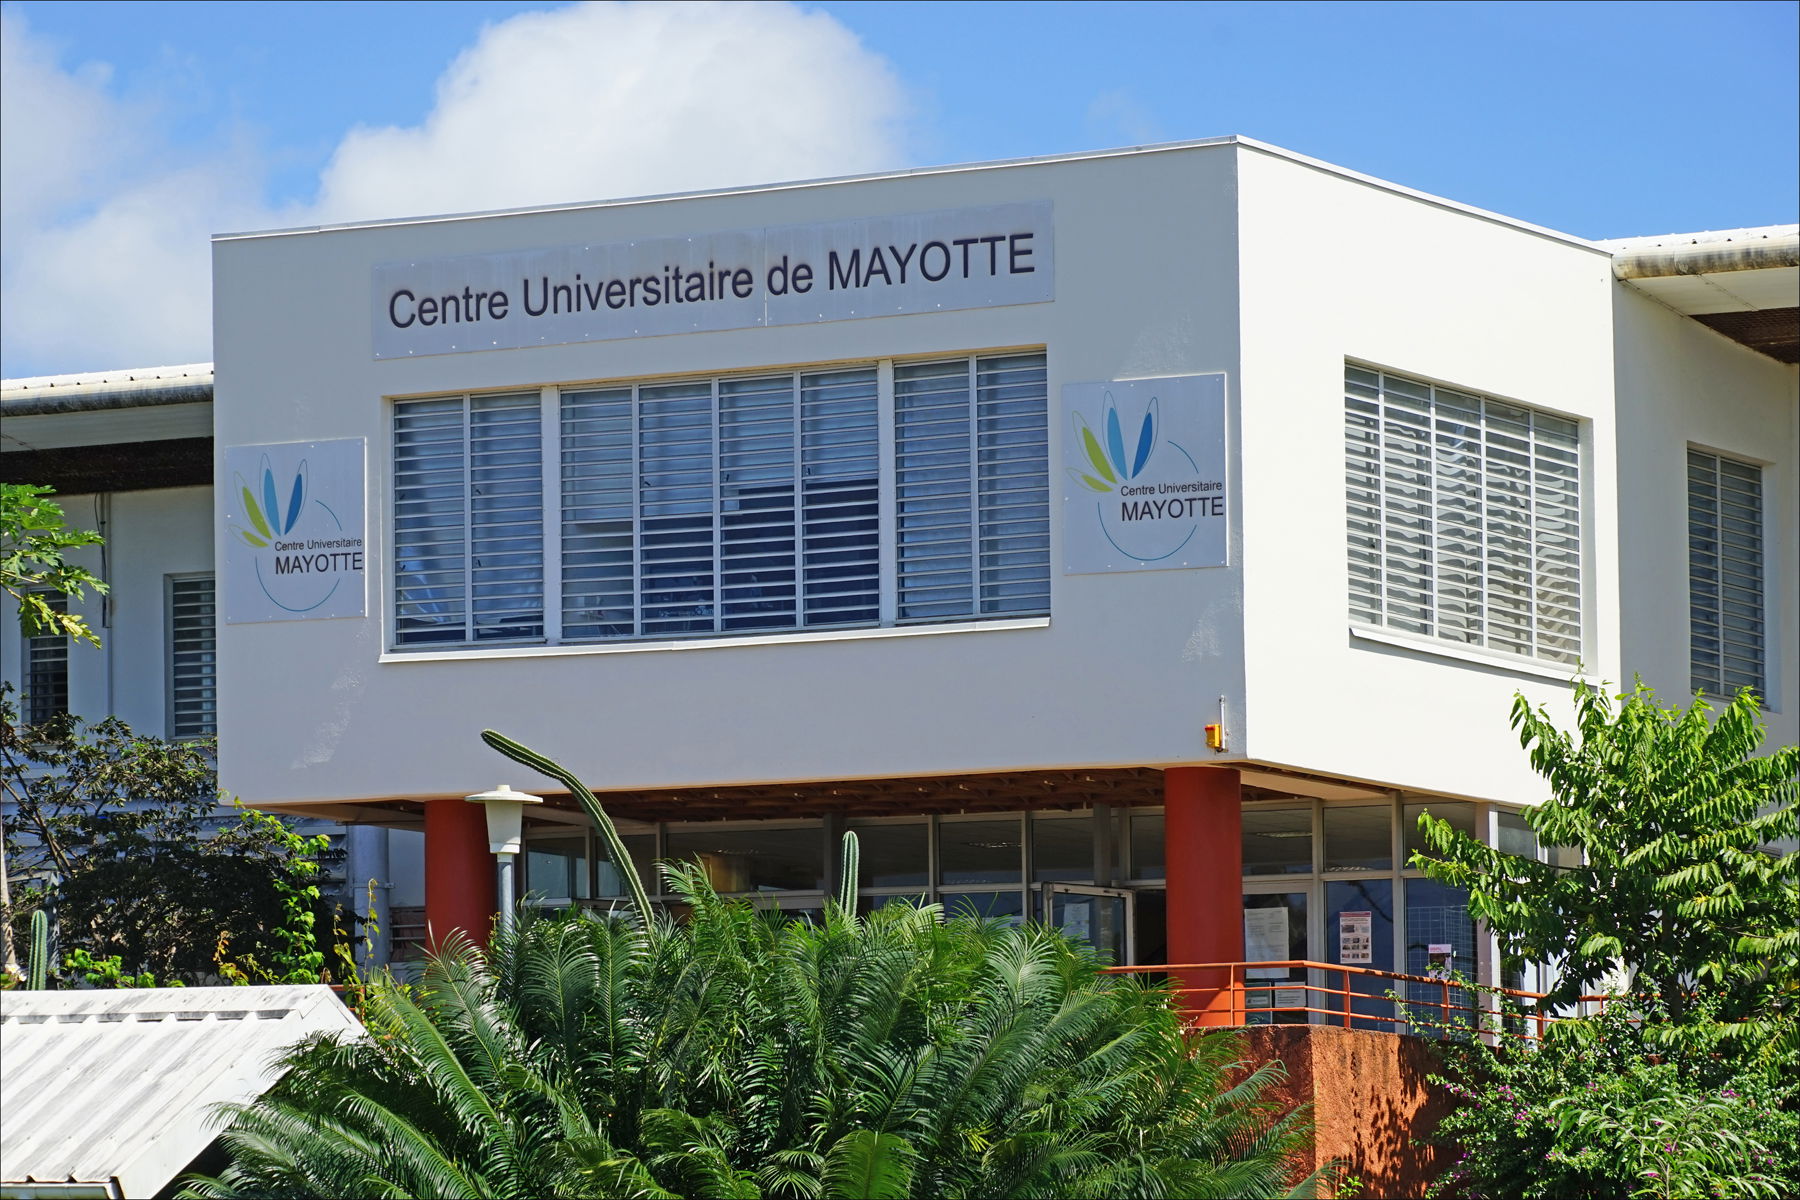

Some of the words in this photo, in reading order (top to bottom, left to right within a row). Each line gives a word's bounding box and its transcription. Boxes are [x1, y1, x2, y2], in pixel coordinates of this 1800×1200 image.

[389, 286, 509, 329] Centre
[523, 260, 753, 317] Universitaire
[767, 255, 813, 296] de
[828, 232, 1035, 291] MAYOTTE
[1120, 485, 1155, 496] Centre
[1158, 481, 1222, 494] Universitaire
[1121, 496, 1224, 521] MAYOTTE
[274, 541, 304, 552] Centre
[307, 538, 362, 550] Universitaire
[275, 552, 363, 575] MAYOTTE
